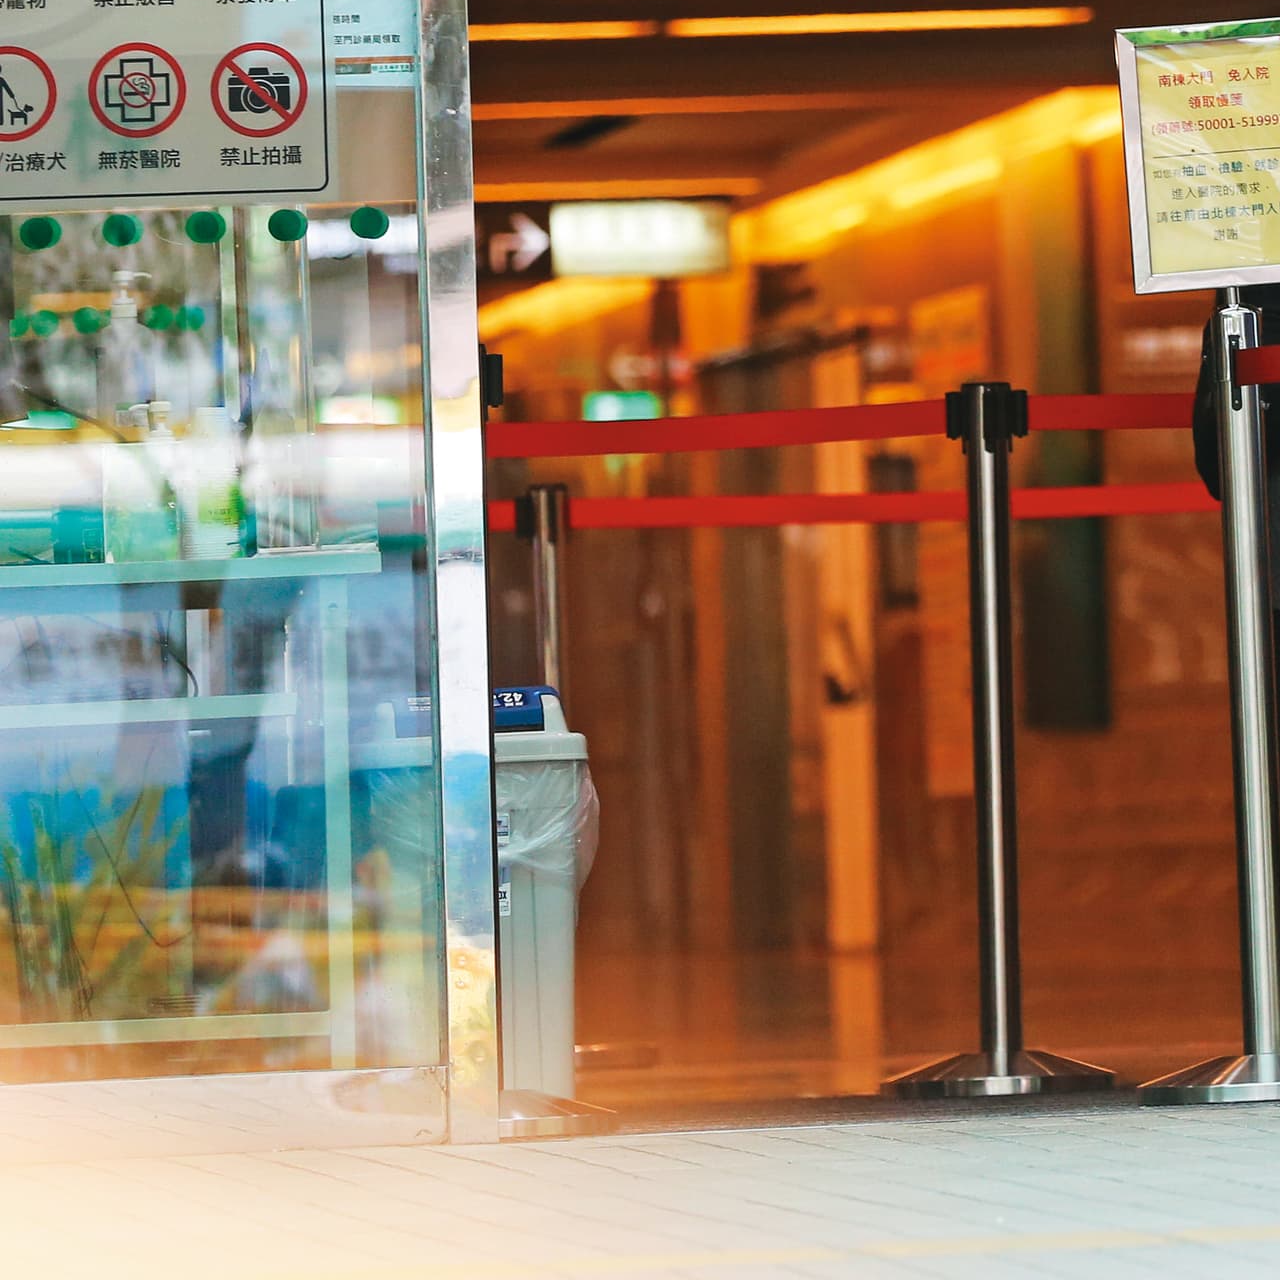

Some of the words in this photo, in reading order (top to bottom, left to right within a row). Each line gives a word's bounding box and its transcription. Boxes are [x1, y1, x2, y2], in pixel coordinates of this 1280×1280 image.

[1158, 70, 1214, 88] 南棟大門
[1228, 66, 1270, 81] 免入院
[98, 148, 181, 170] 無菸醫院
[220, 145, 303, 167] 禁止拍攝
